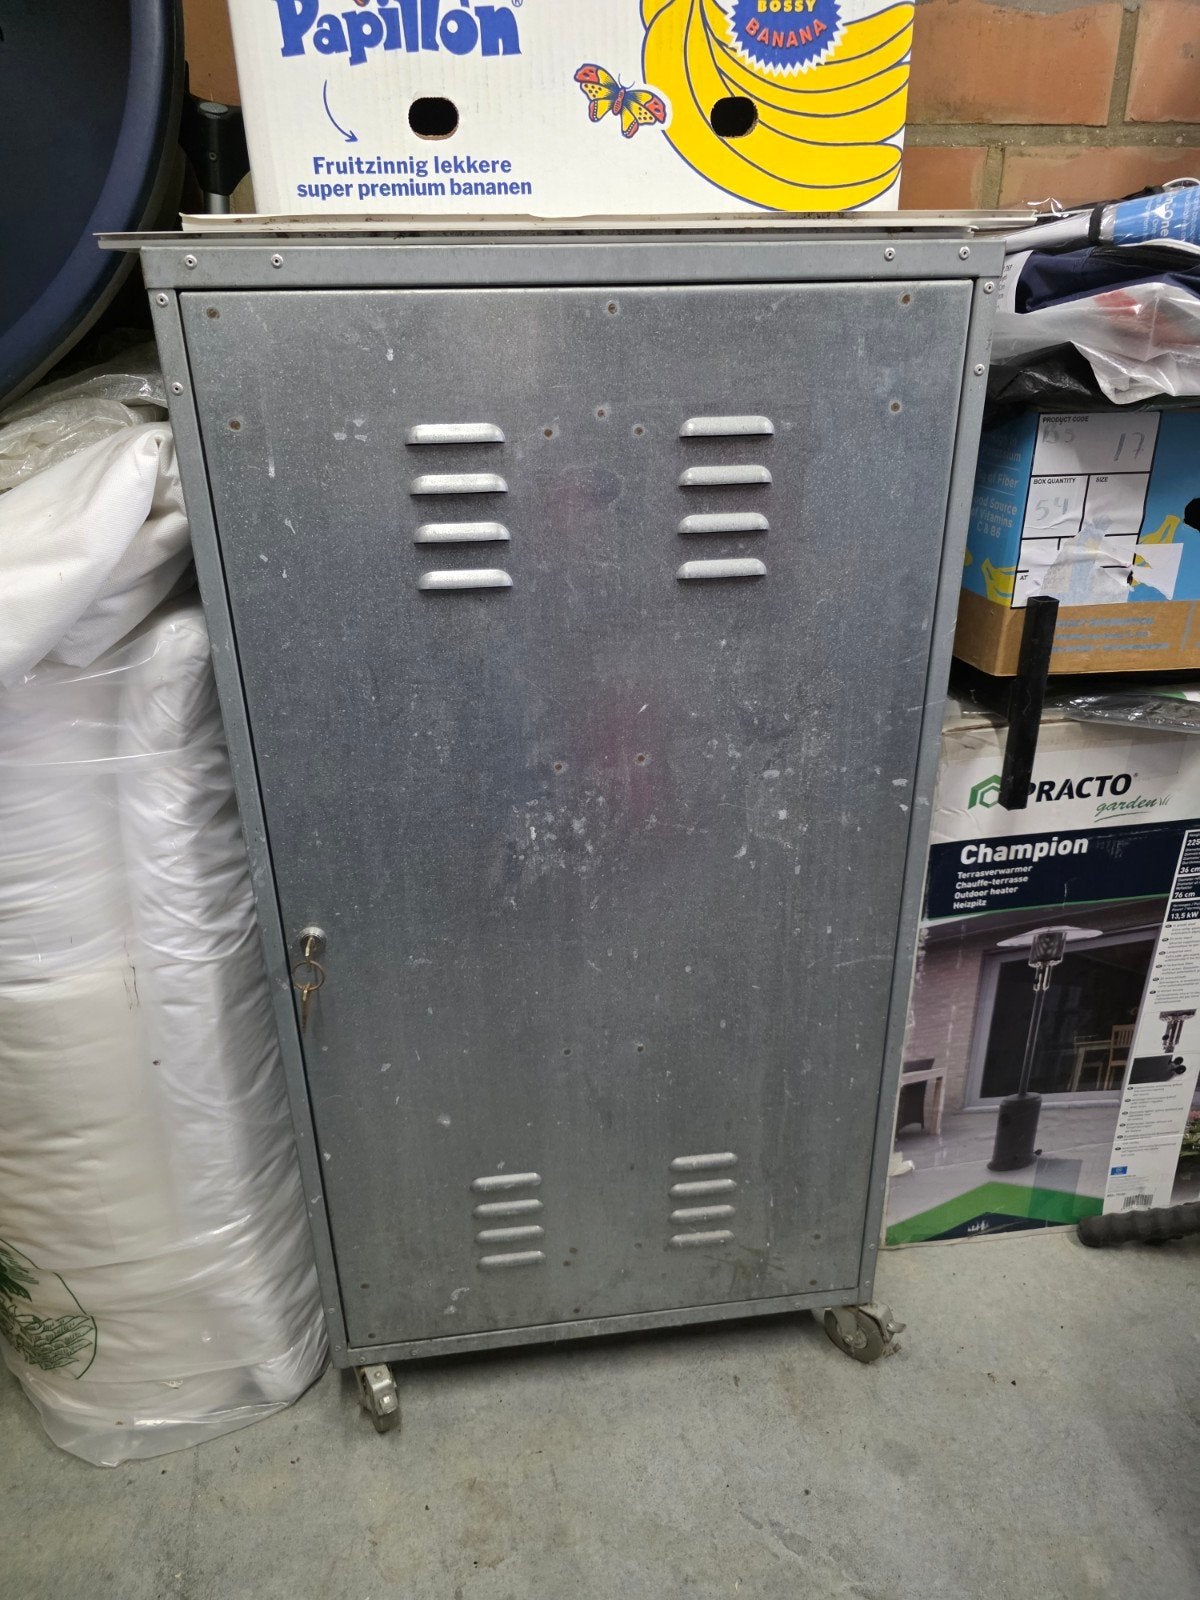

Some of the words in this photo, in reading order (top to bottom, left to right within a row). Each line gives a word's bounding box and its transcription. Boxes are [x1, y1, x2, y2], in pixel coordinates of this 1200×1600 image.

[757, 0, 816, 12] BOSSY
[745, 17, 827, 48] BANANA
[313, 156, 428, 177] Fruitzinnig
[434, 156, 512, 174] lekkere
[297, 183, 353, 201] super
[358, 178, 446, 200] premium
[450, 178, 532, 196] bananen
[989, 498, 1018, 516] Source
[1094, 795, 1158, 817] garden
[960, 837, 1089, 865] Champion
[957, 865, 1033, 879] Terrasverwarmer
[955, 876, 1029, 889] Chauffe-terrasse
[954, 889, 988, 900] Outdoor
[989, 886, 1019, 896] heater
[1186, 910, 1199, 918] kW
